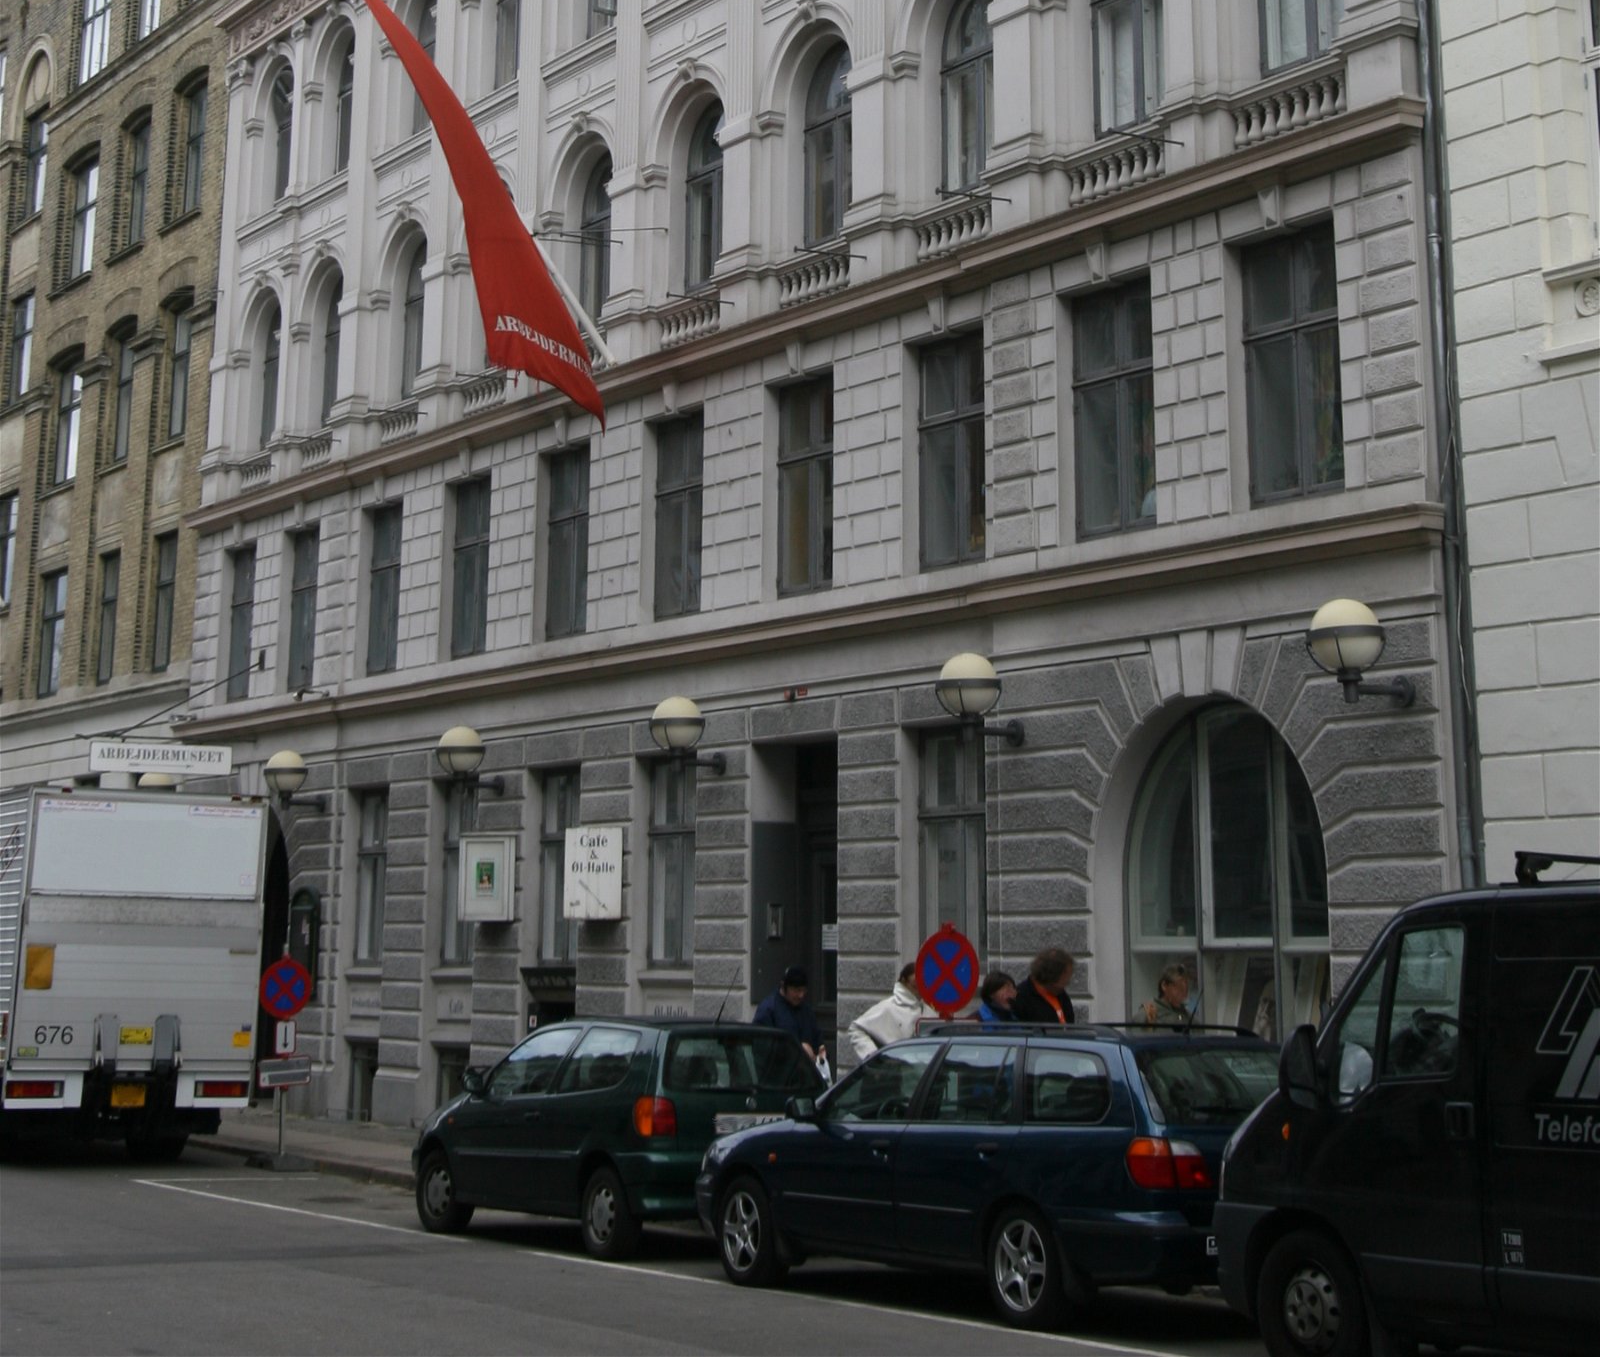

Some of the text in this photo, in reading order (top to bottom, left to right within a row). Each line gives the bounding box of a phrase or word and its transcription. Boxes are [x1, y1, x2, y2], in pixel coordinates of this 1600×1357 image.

[98, 747, 224, 763] ARBEJDERMUSEET
[580, 835, 608, 847] Café
[571, 861, 615, 873] Øl-Halle
[35, 1026, 73, 1044] 676
